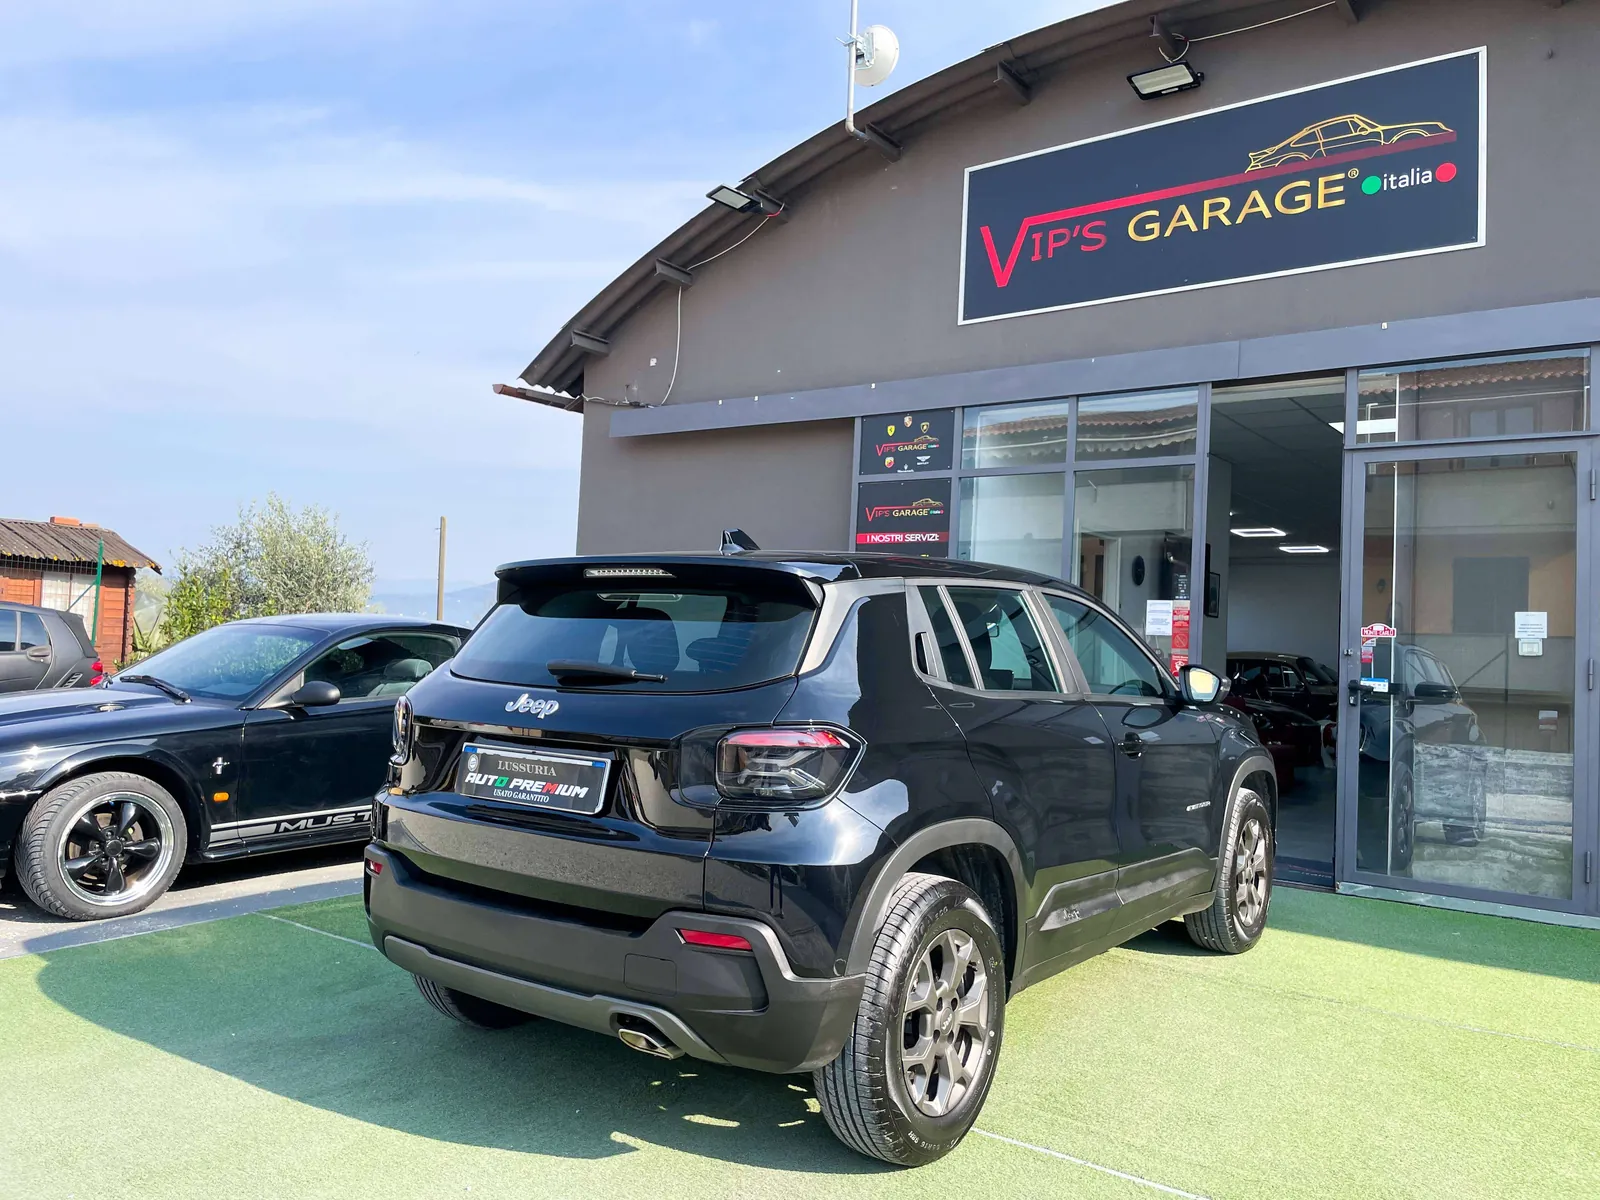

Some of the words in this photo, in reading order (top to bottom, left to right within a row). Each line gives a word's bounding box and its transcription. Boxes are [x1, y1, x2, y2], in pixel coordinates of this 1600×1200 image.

[980, 217, 1107, 288] VIP'S
[1383, 166, 1433, 191] italia
[871, 534, 903, 542] NOSTRI
[505, 693, 560, 719] Jeep
[497, 760, 557, 777] LUSSURIA
[465, 772, 509, 788] AUTO
[509, 778, 589, 799] PREMIUM
[493, 788, 513, 799] USATO
[512, 790, 549, 803] GARANTITO
